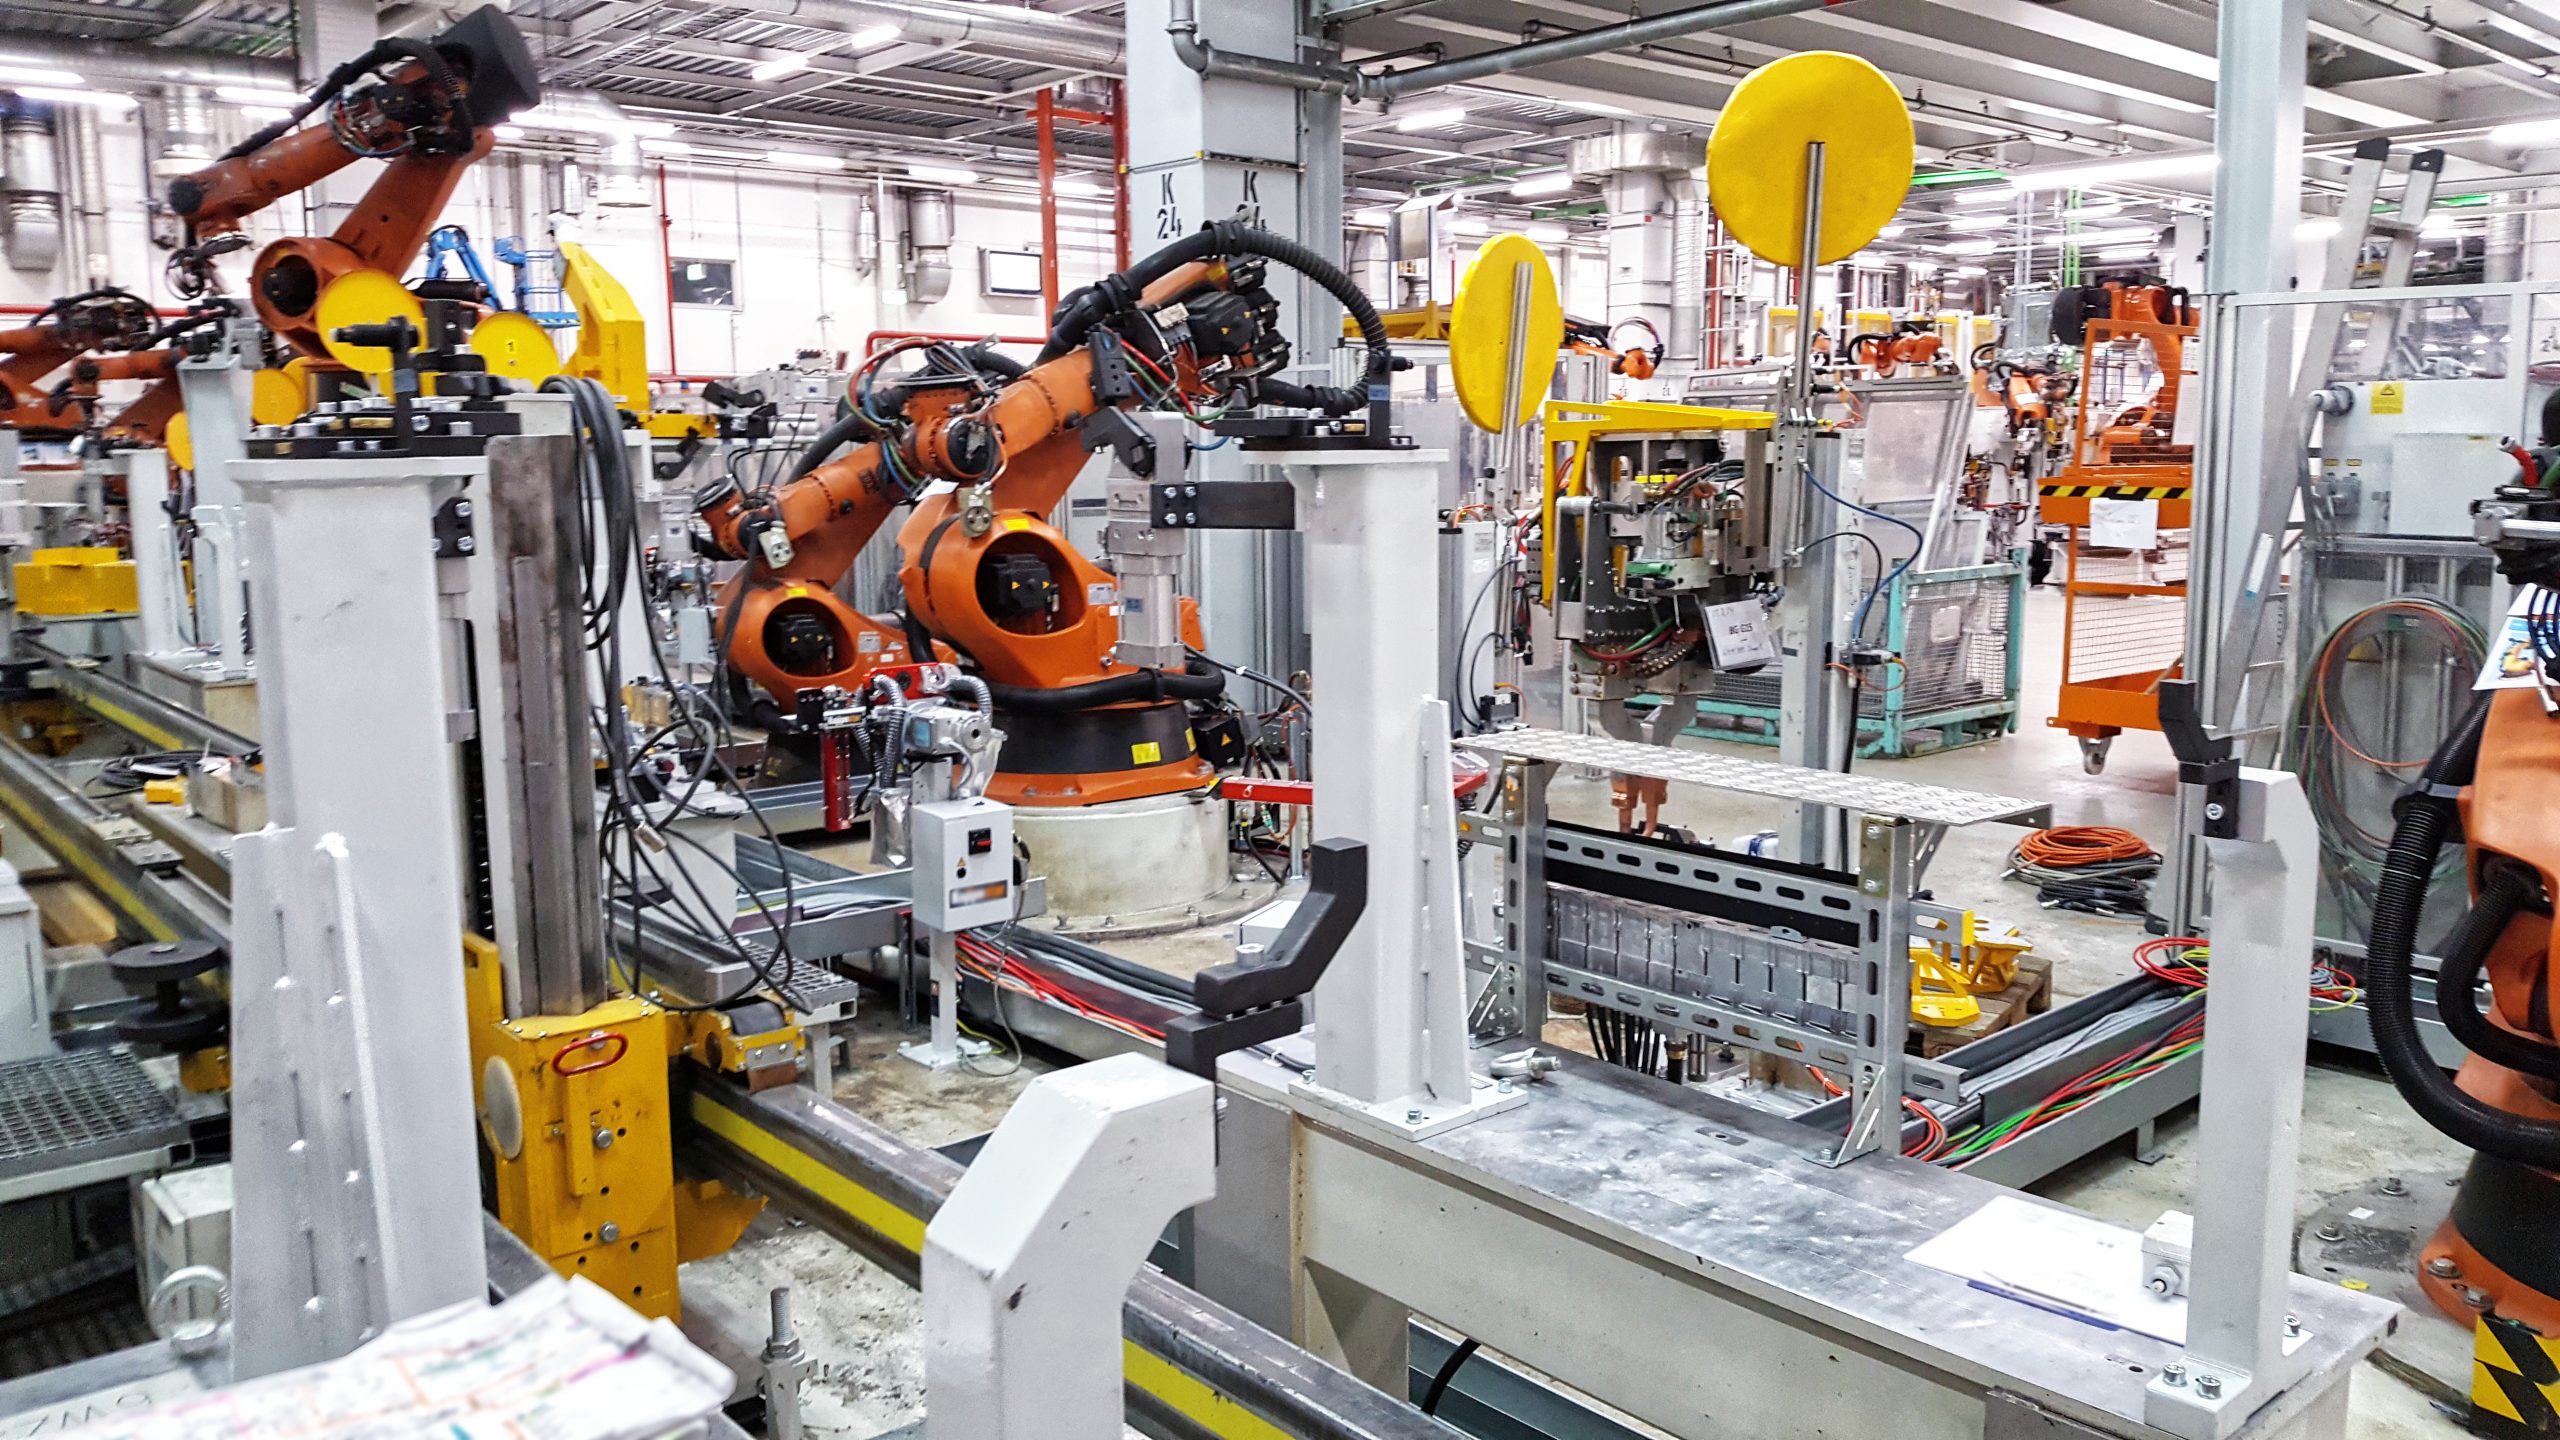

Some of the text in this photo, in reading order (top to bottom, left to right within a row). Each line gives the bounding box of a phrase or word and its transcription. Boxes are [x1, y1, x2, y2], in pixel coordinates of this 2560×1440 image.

[1162, 173, 1175, 205] K
[1244, 170, 1258, 203] K
[1156, 206, 1182, 240] 24
